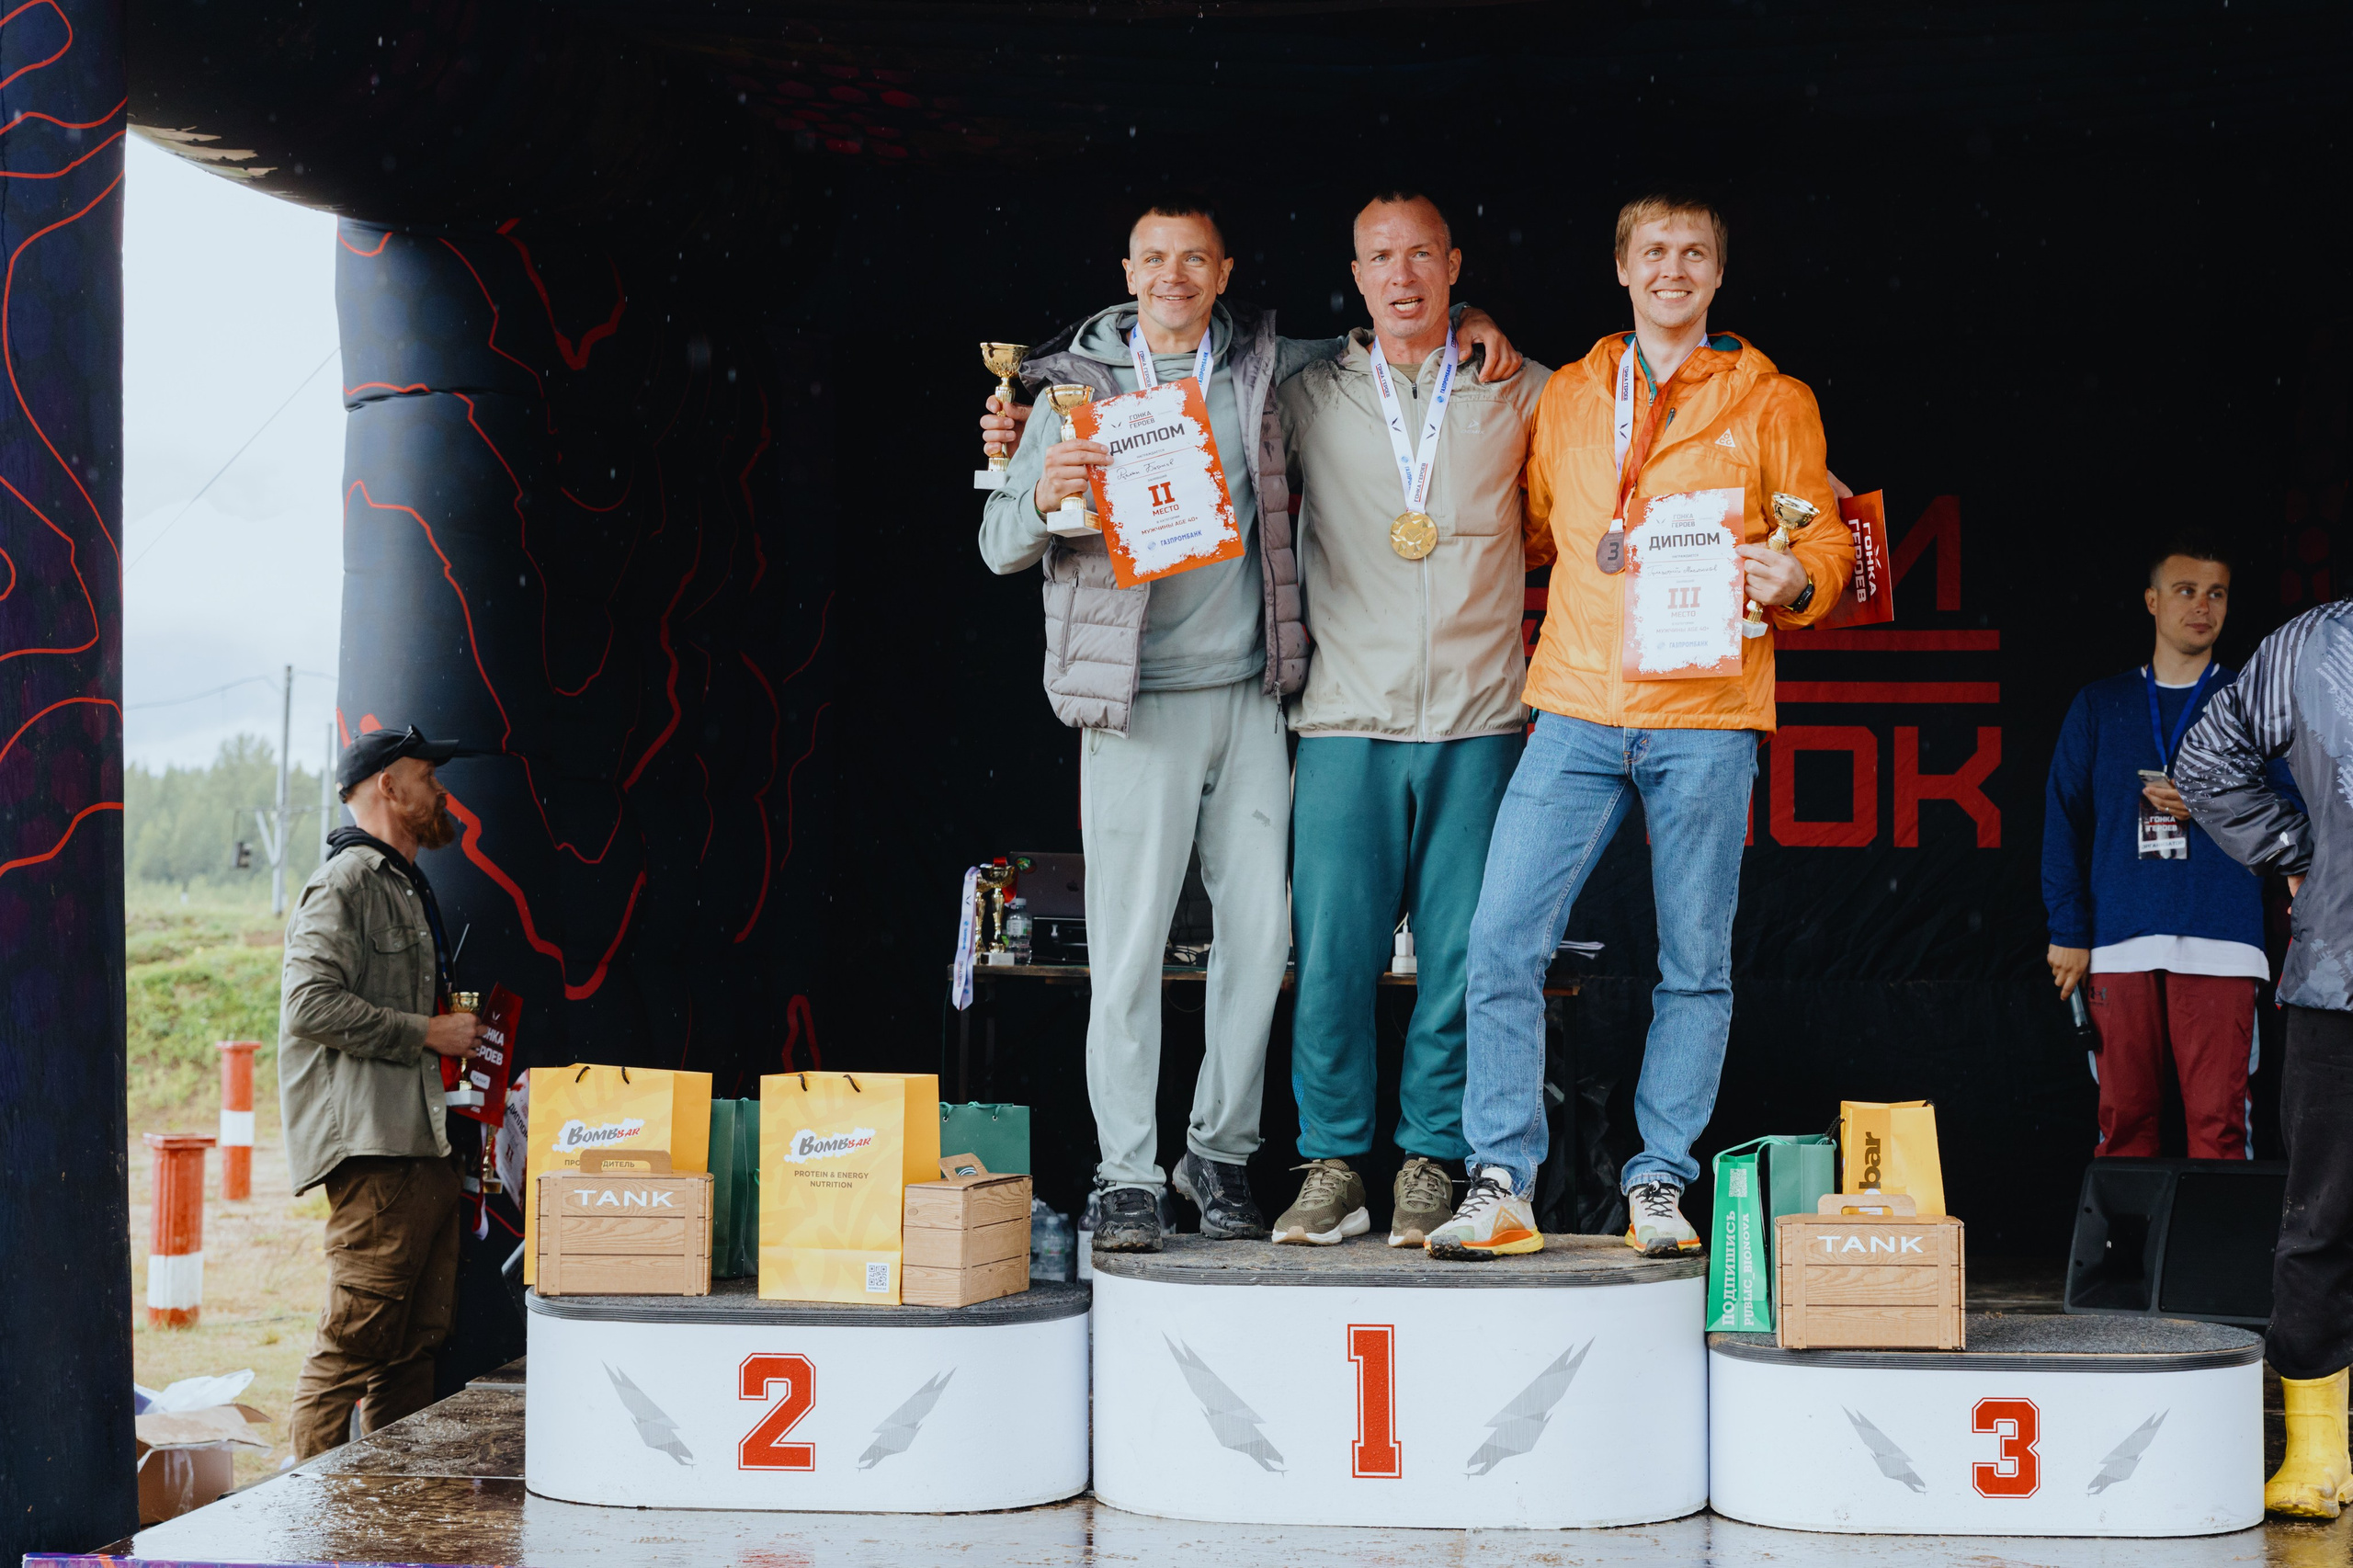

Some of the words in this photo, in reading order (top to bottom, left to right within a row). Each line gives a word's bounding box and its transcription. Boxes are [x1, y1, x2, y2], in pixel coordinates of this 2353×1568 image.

[1440, 363, 1452, 394] ГАЗПРОМБАНК
[1129, 411, 1152, 421] ГОНКА
[1130, 417, 1155, 429] ГЕРОЕВ
[1109, 423, 1186, 456] ДИПЛОМ
[1418, 463, 1427, 483] ГЕРОЕВ
[1148, 482, 1175, 507] II
[1153, 504, 1179, 516] МЕСТО
[1142, 523, 1174, 535] МУЖЧИНЫ
[1160, 530, 1202, 546] ГАЗПРОМБАНК
[1608, 542, 1620, 561] 3
[1648, 532, 1721, 551] ДИПЛОМ
[1848, 518, 1867, 603] ГЕРОЕВ
[1863, 522, 1877, 597] ГОНКА
[1667, 586, 1701, 609] III
[483, 1028, 505, 1047] НКА
[564, 1159, 635, 1168] ПРОДИТЕЛЬ
[574, 1189, 674, 1208] TANK
[1816, 1235, 1924, 1254] TANK
[1722, 1210, 1737, 1325] ПОДПИШИСЬ
[1743, 1213, 1755, 1326] PUBLIC_BIONOVA
[738, 1352, 816, 1471] 2
[1347, 1324, 1403, 1479] 1
[1971, 1397, 2040, 1499] 3
